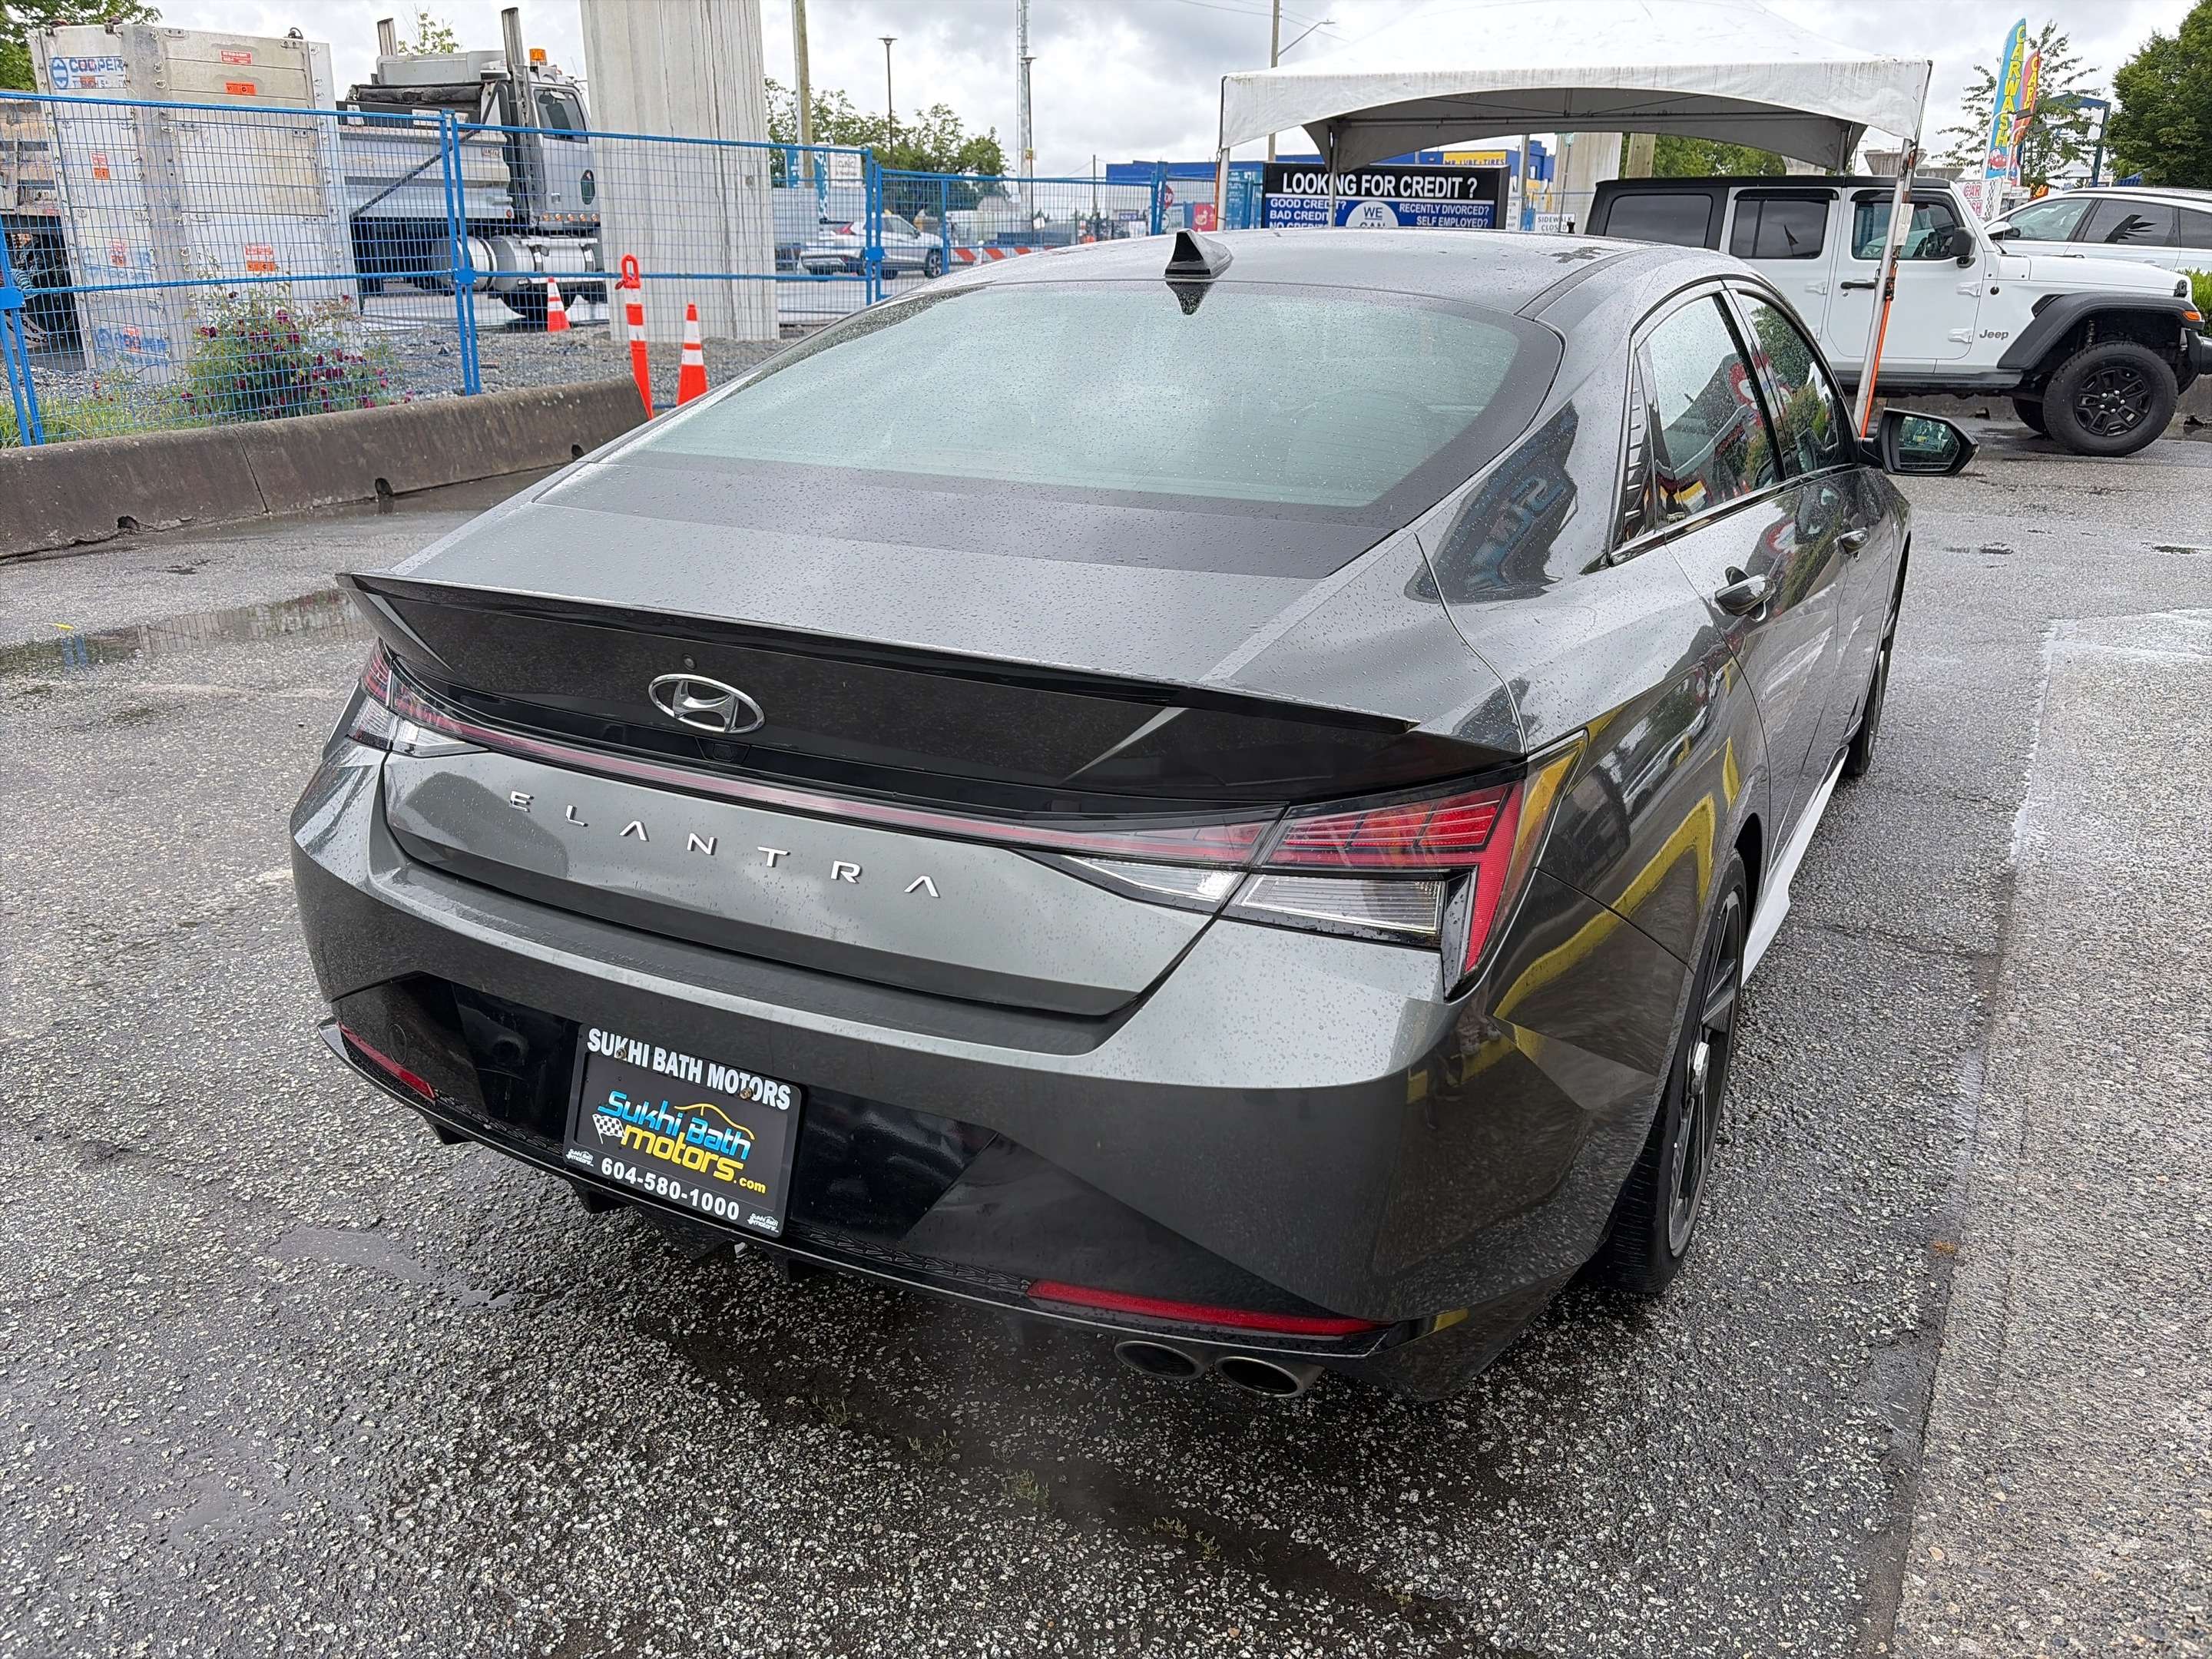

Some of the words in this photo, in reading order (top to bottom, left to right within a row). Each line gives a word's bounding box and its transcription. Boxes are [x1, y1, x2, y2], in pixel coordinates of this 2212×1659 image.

[69, 58, 124, 72] COOPER
[1283, 172, 1356, 195] LOOKNG
[1361, 175, 1396, 196] FOR
[1400, 177, 1462, 197] CREDIT
[1964, 183, 1982, 198] CAR
[1270, 198, 1300, 208] GOOD
[1303, 200, 1346, 210] CREDT?
[1399, 203, 1440, 214] RECENTLY
[1442, 205, 1489, 216] DIVORCED?
[1270, 210, 1291, 220] BAD
[1364, 207, 1382, 217] WE
[1416, 217, 1437, 226] SELF
[1439, 217, 1488, 228] EMPLOYED?
[1979, 329, 2008, 340] Jeep
[510, 790, 940, 898] ELANTRA
[587, 1028, 649, 1068] SUKHI
[653, 1046, 703, 1084] BATH
[707, 1063, 791, 1111] MOTORS
[597, 1091, 683, 1137] Sukhi
[687, 1116, 751, 1161] Bath
[601, 1157, 740, 1220] 604-580-1000
